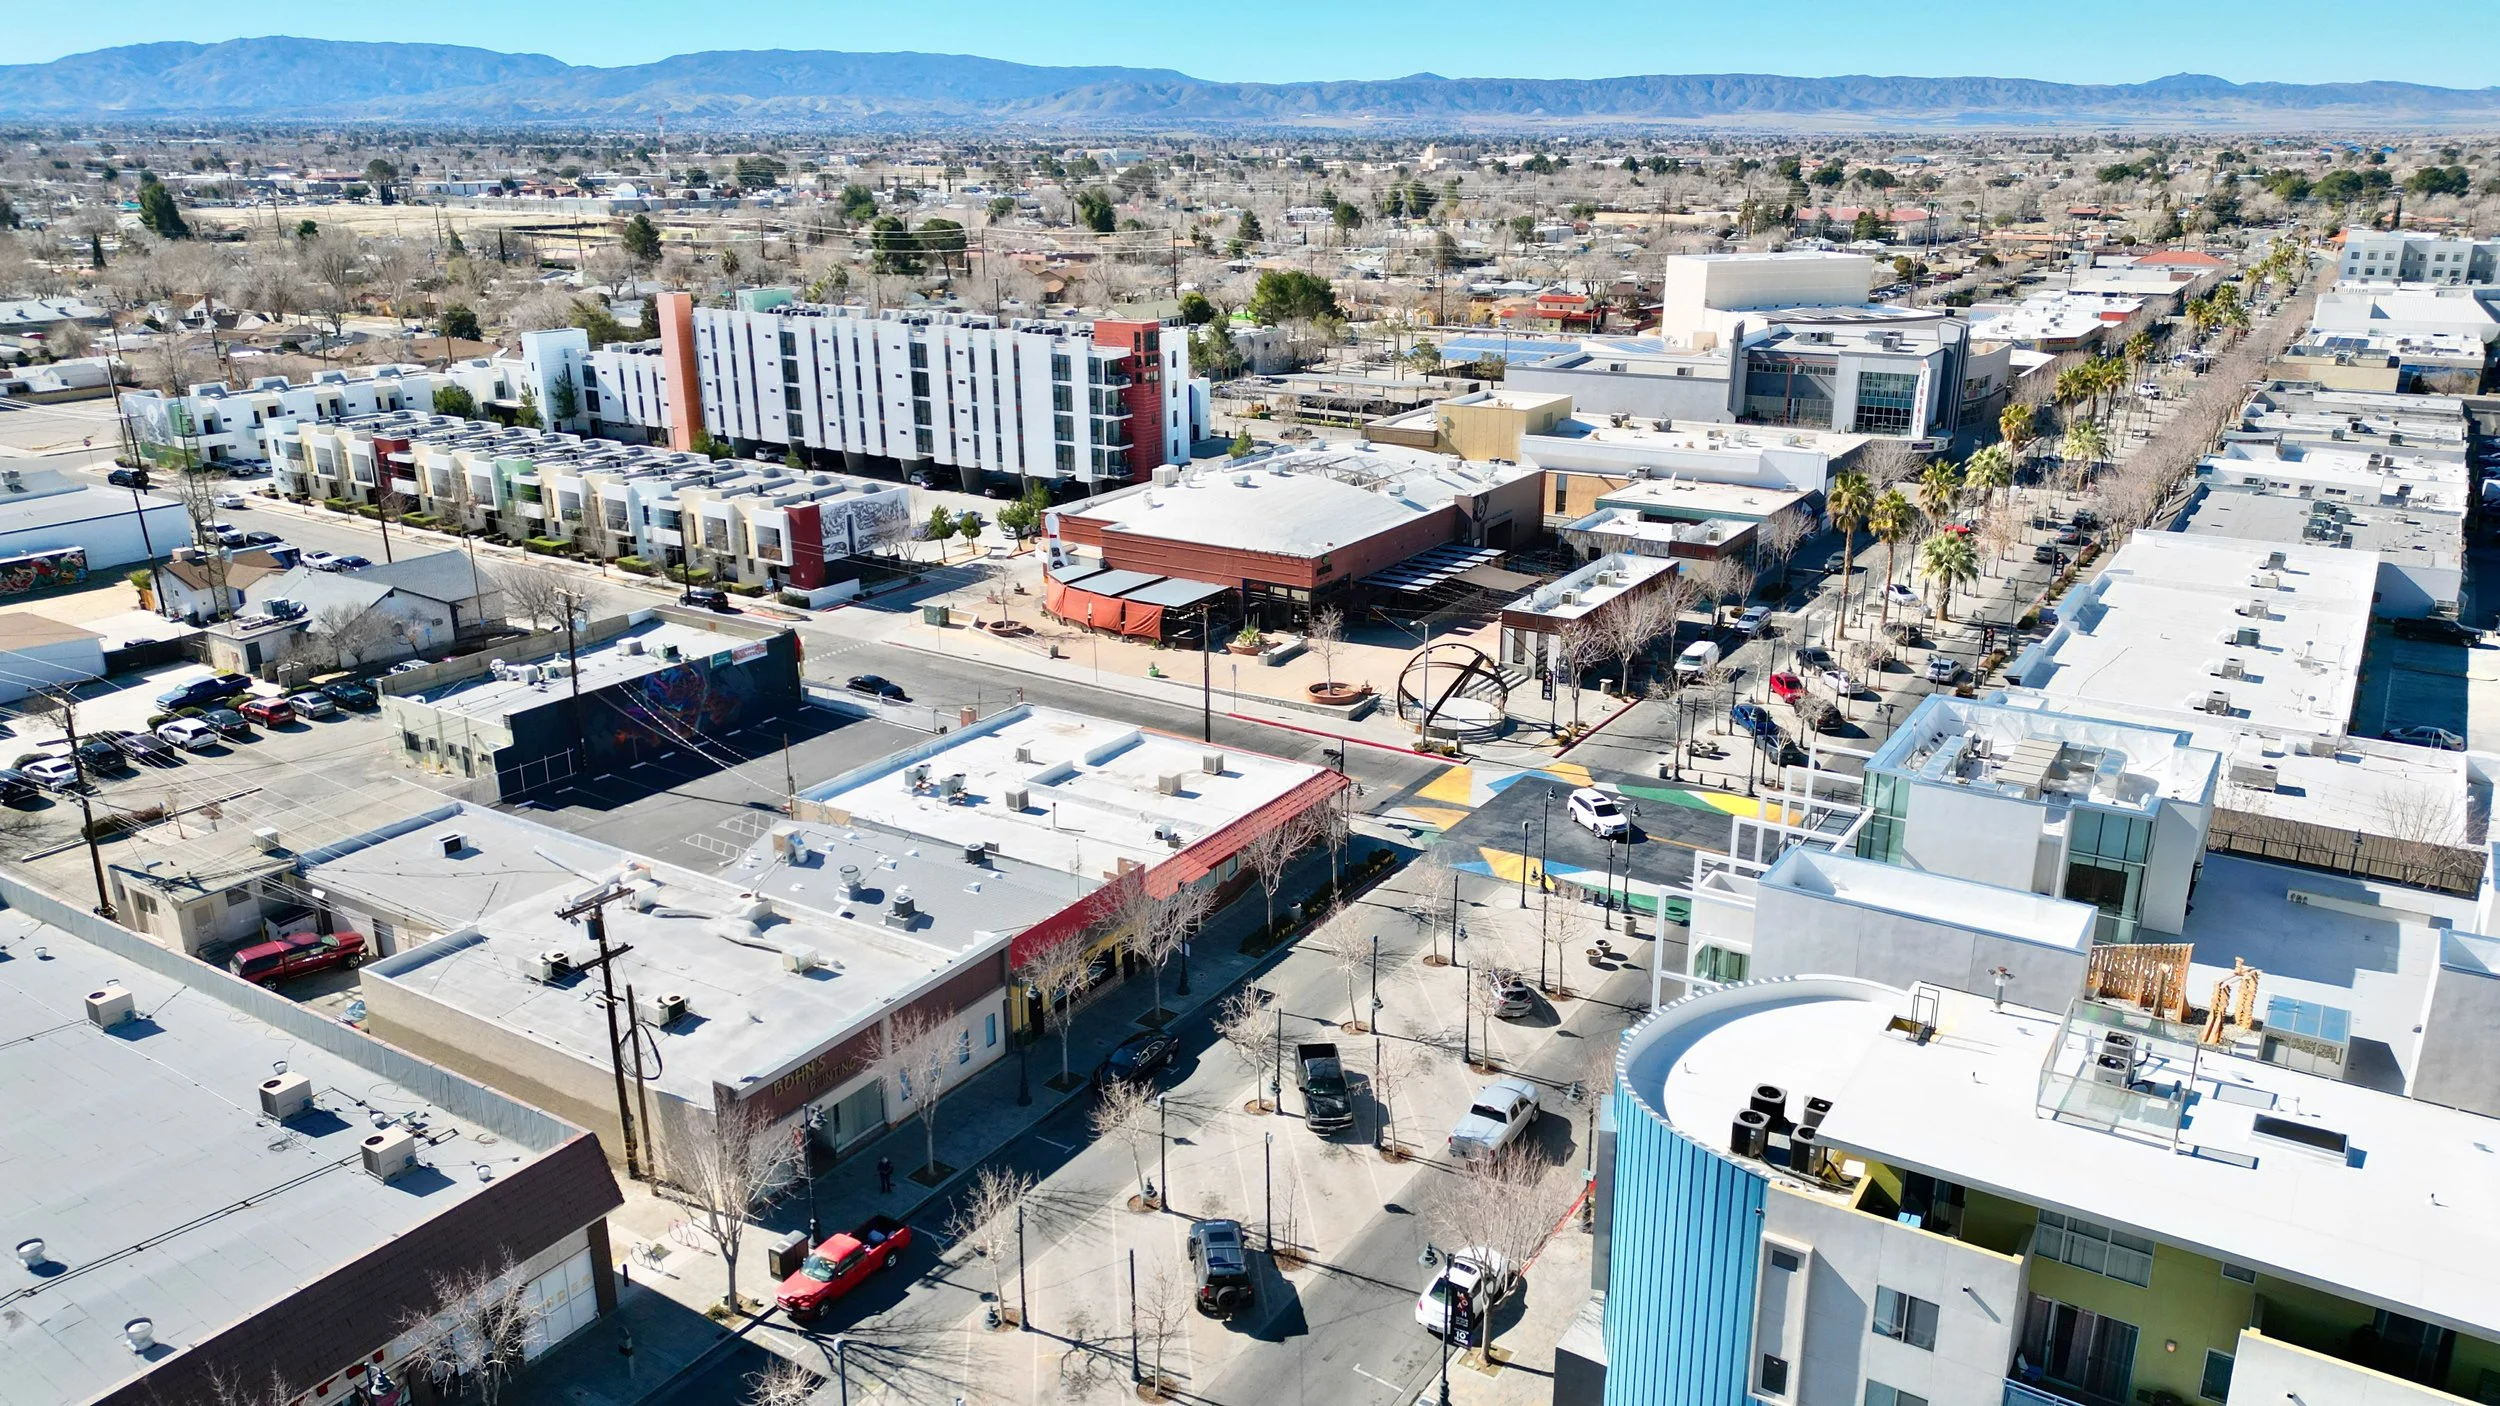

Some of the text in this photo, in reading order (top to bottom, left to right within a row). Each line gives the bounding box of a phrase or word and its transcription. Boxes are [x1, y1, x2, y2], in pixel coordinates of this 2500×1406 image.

[773, 1055, 826, 1097] BOHN'S
[808, 1057, 856, 1093] PRINTING
[1456, 1331, 1466, 1340] 10
